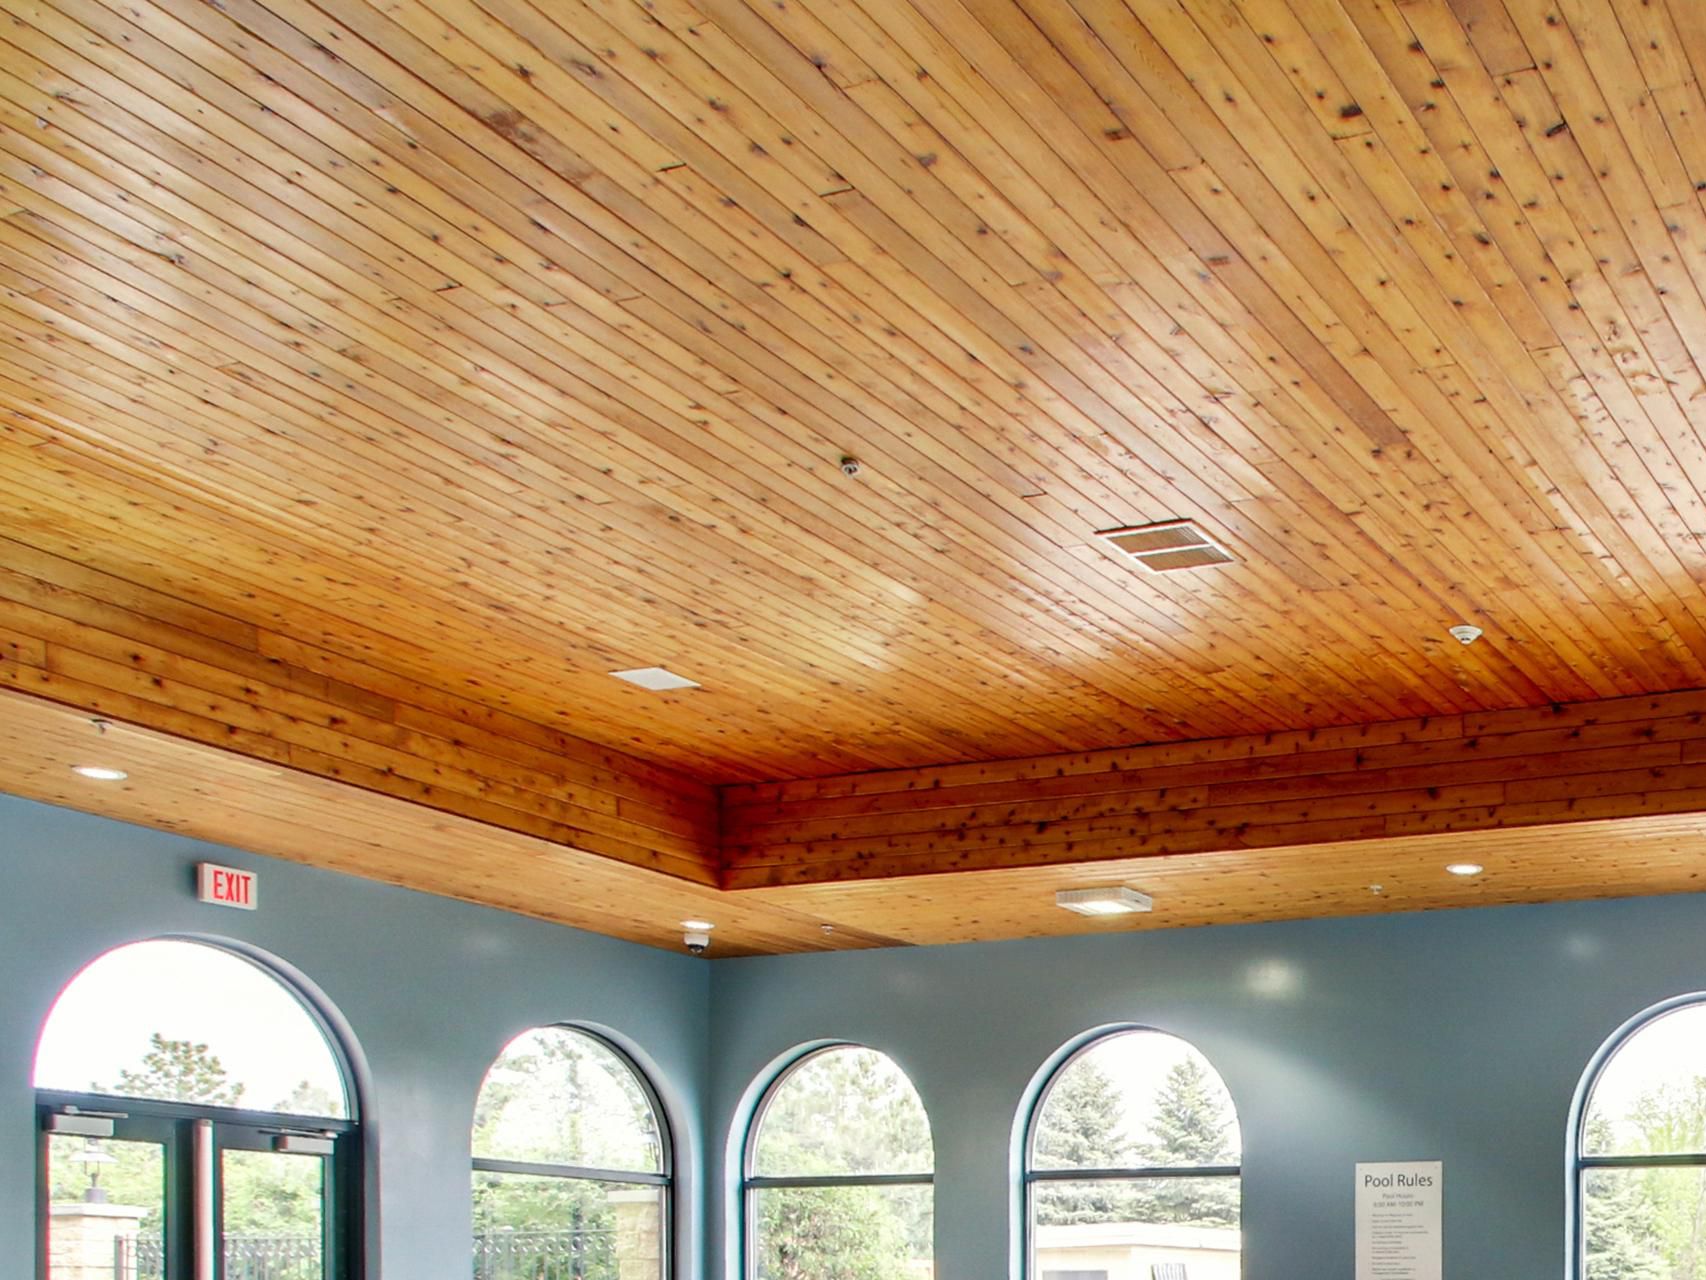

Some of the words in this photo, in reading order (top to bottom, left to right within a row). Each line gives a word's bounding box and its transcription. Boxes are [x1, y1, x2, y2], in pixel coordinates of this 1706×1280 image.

[213, 870, 251, 904] EXIT
[1364, 1174, 1394, 1188] Pool
[1397, 1173, 1433, 1187] Rules
